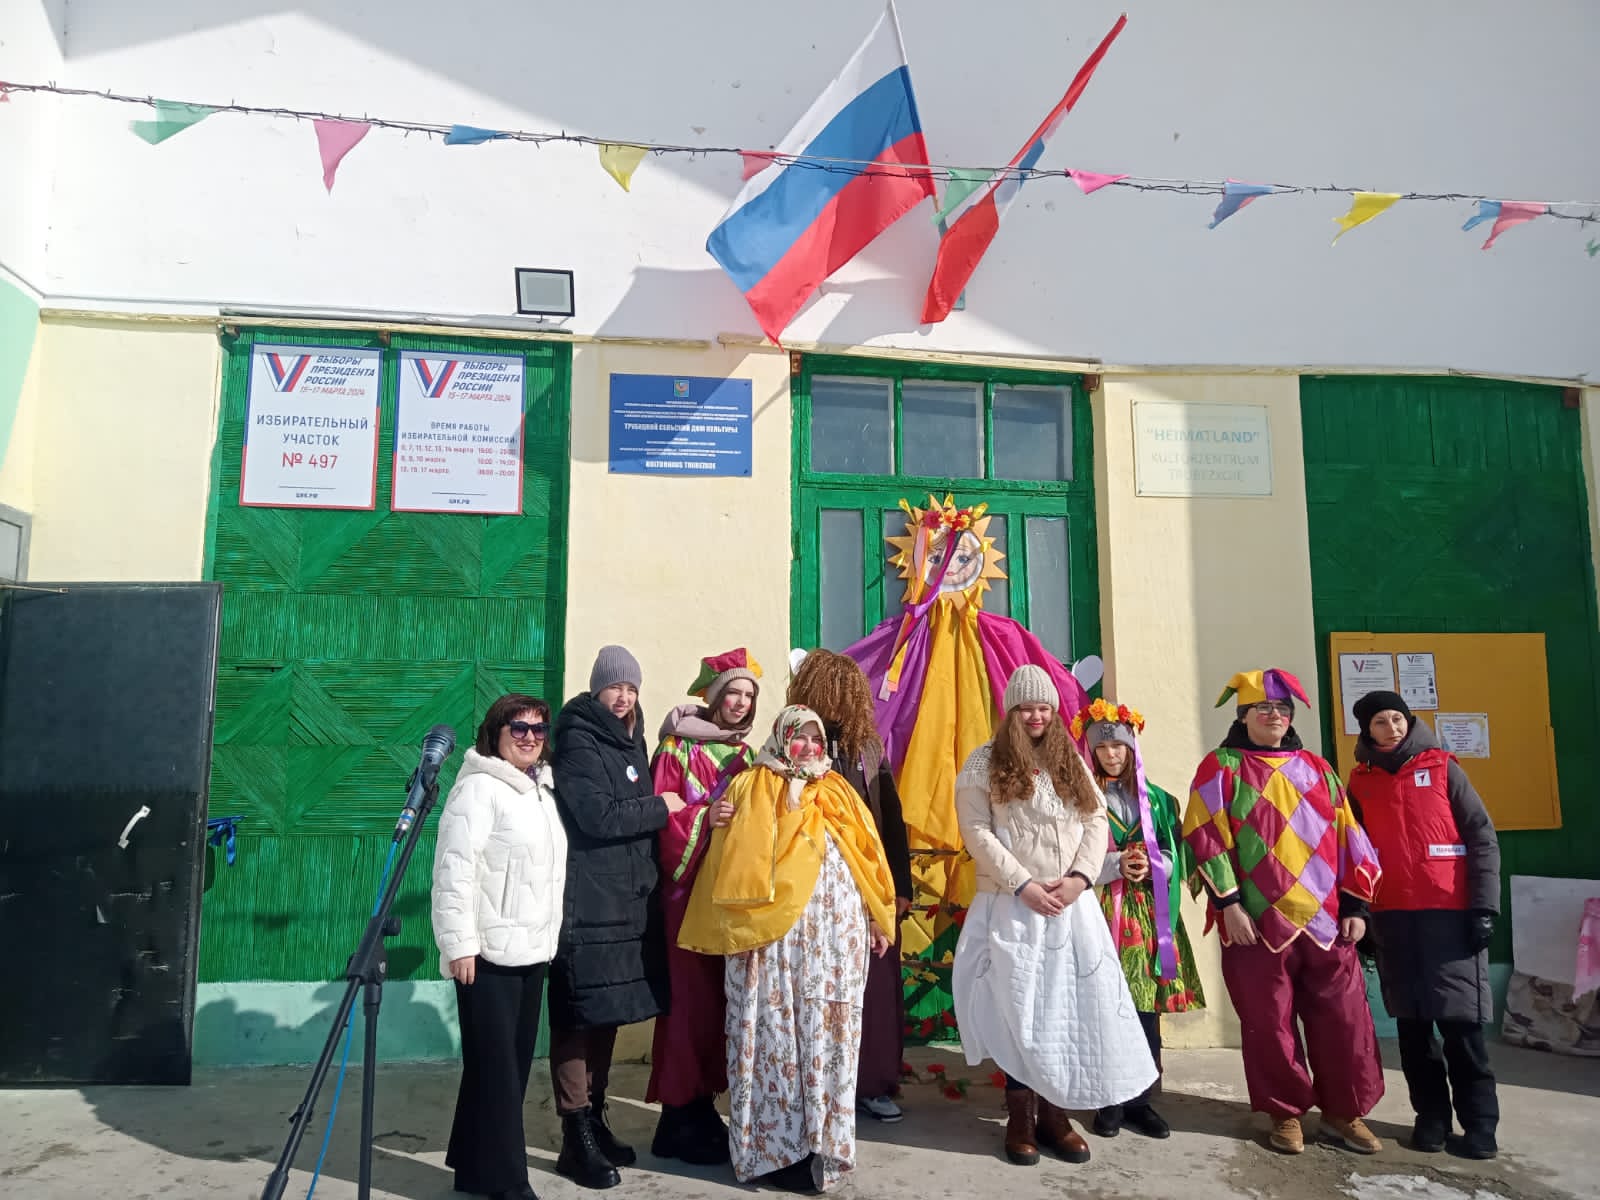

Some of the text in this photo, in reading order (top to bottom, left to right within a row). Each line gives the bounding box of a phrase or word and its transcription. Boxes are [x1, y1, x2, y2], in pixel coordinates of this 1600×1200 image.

[316, 355, 362, 365] ВЫБОРЫ
[310, 365, 375, 377] ПРЕЗИДЕНТА
[463, 361, 508, 371] ВЫБОРЫ
[304, 376, 347, 385] РОССИИ
[457, 371, 520, 383] ПРЕЗИДЕНТА
[320, 387, 346, 396] МАРТА
[451, 382, 493, 392] РОССИИ
[469, 393, 493, 401] МАРТА
[256, 414, 368, 430] ИЗБИРАТЕЛЬНЫЙ
[431, 421, 490, 432] ВРЕМЯ РАБОТЫ
[282, 433, 340, 446] УЧАСТОК
[401, 432, 468, 442] ИЗБИРАТЕЛЬНОЙ
[282, 452, 338, 469] № 497
